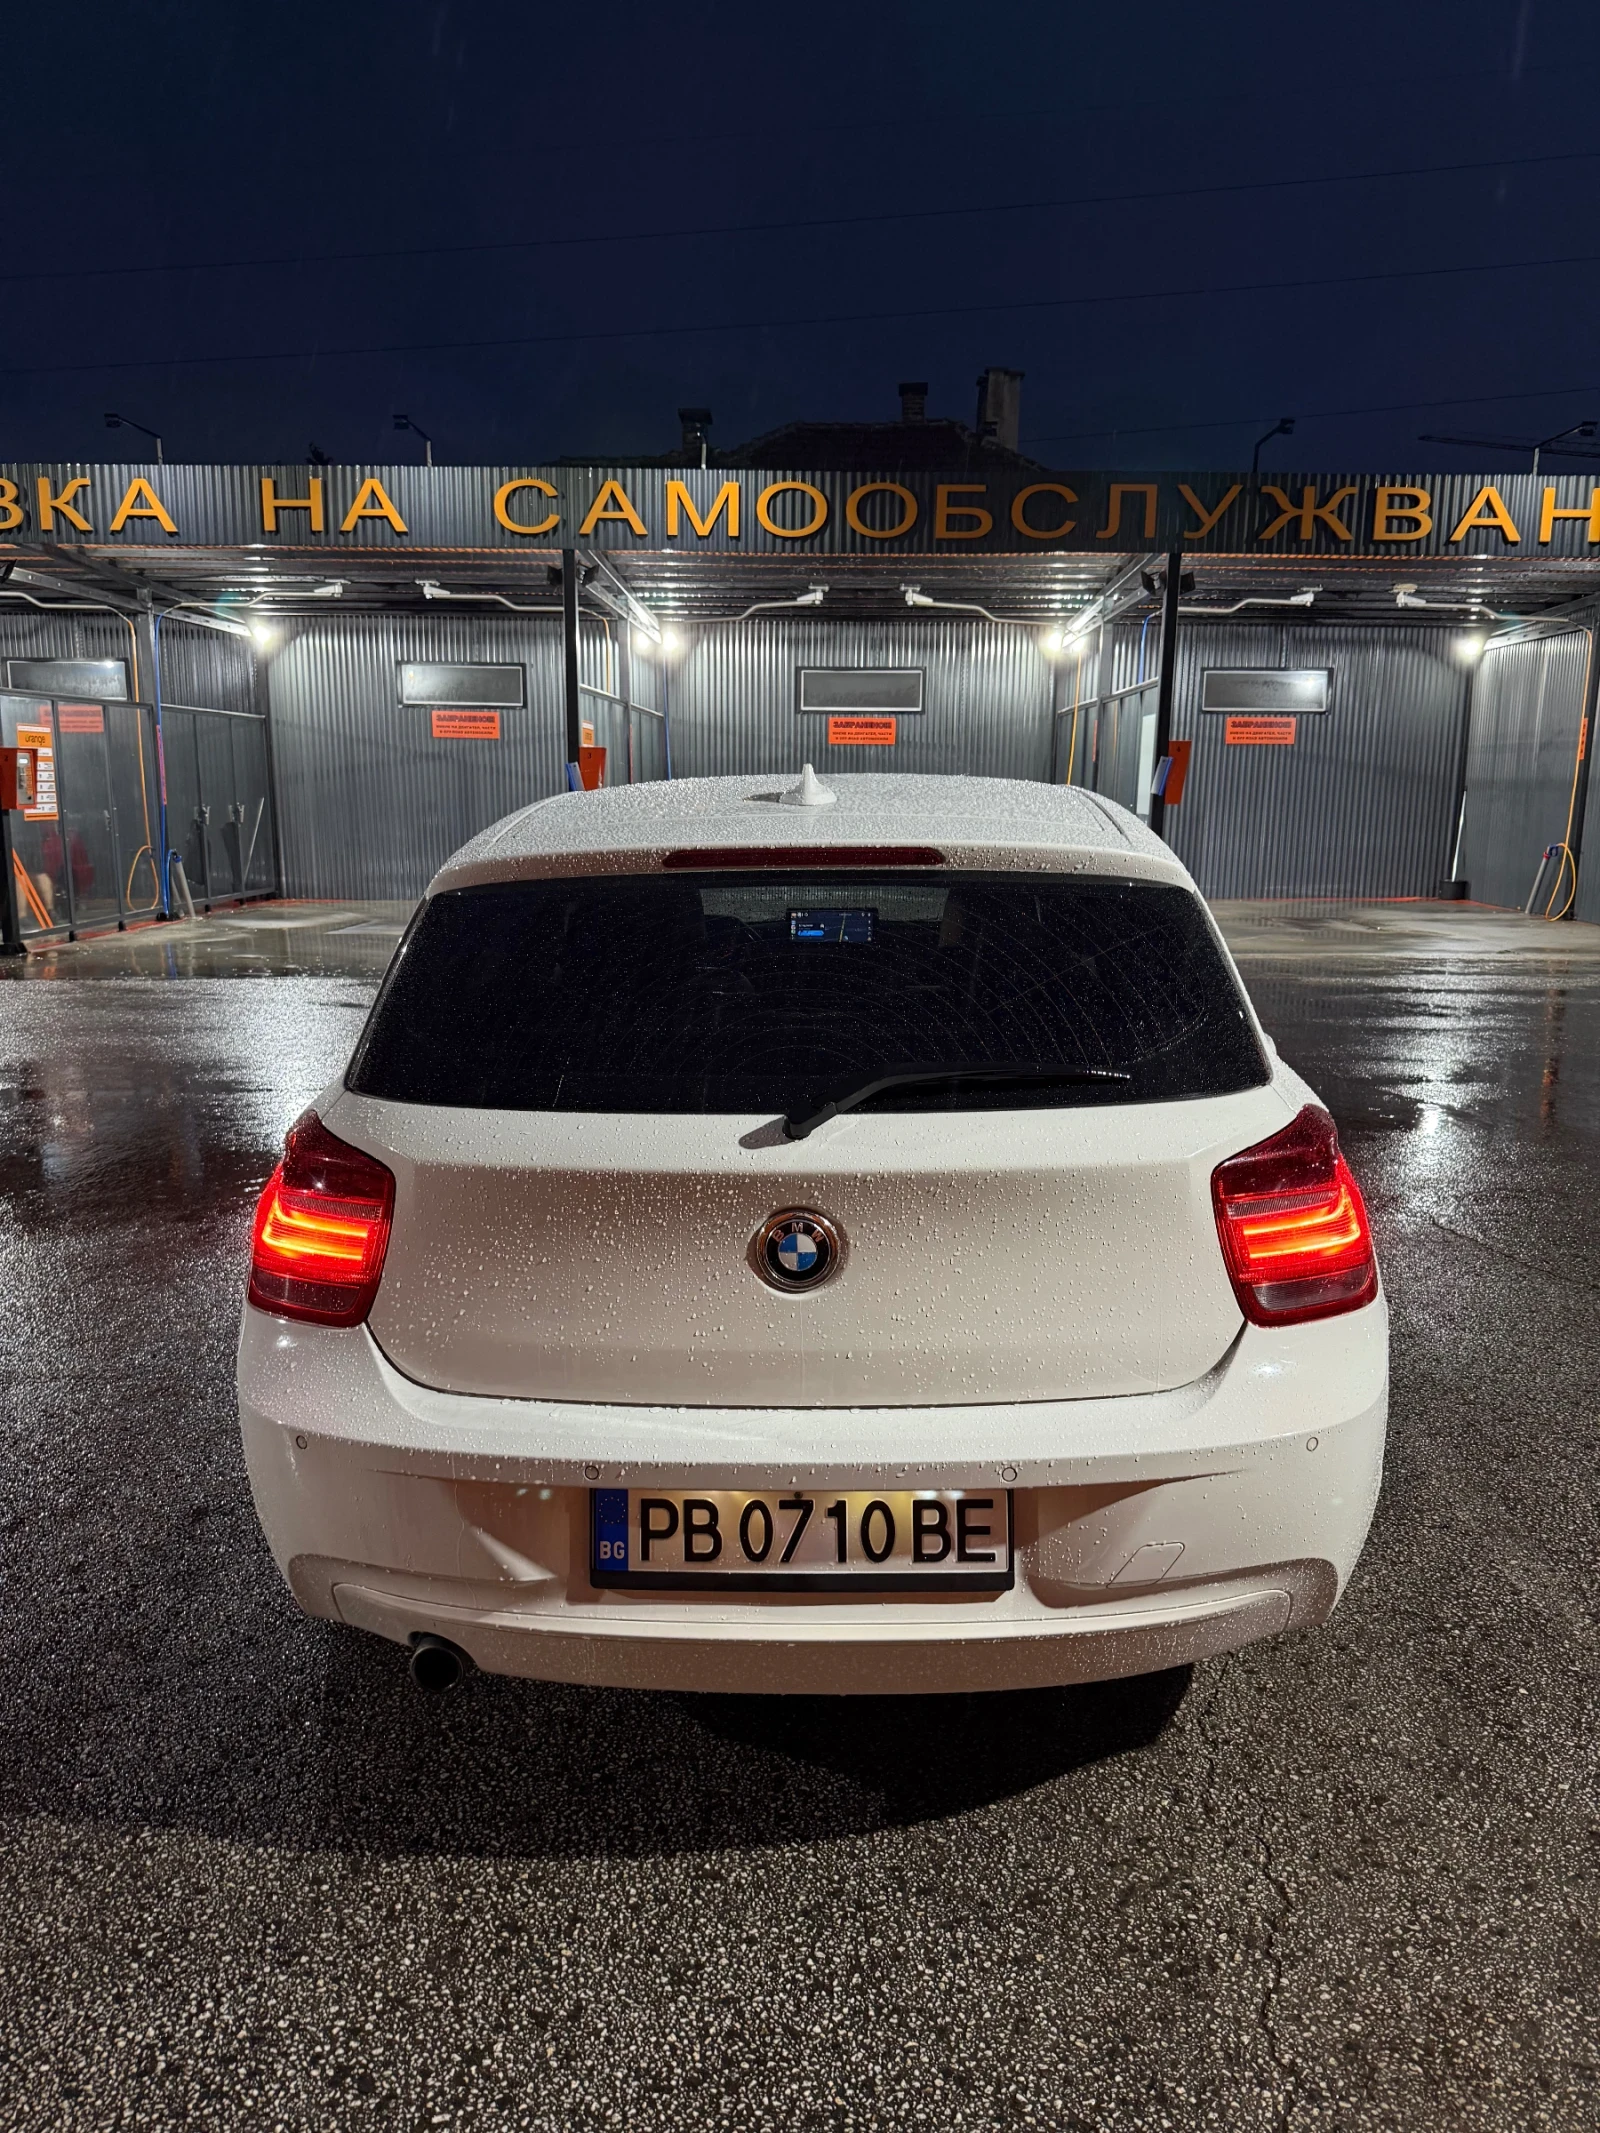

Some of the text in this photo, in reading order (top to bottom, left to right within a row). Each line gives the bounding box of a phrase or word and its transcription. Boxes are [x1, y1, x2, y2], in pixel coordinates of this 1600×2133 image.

[261, 478, 408, 533] НА
[493, 478, 1600, 542] САМООБСЛУЖВАН
[772, 1222, 824, 1243] BMW
[599, 1541, 626, 1560] BG
[640, 1498, 997, 1564] PB 0710 BE
